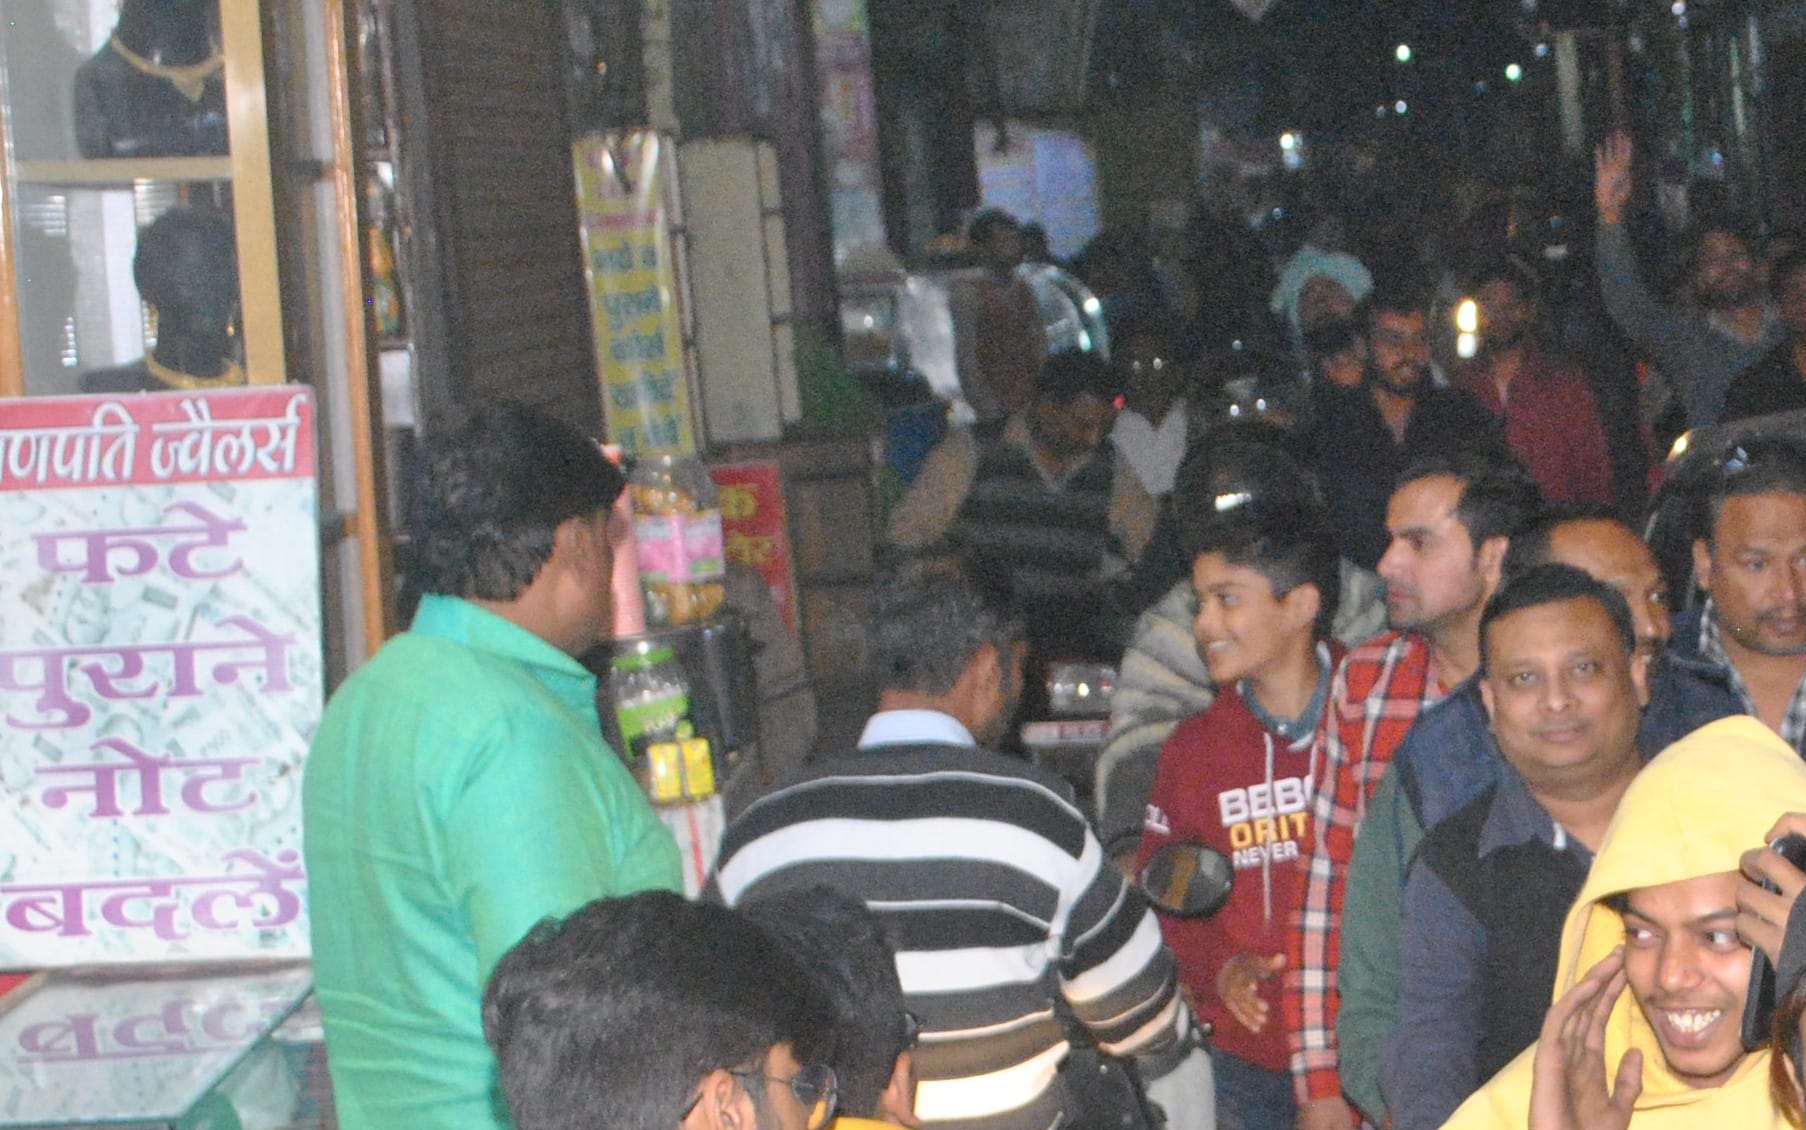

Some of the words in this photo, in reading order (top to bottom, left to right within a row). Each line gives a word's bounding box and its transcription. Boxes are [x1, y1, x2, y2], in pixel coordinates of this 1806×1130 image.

[0, 401, 140, 484] णपति
[31, 501, 247, 584] फटे
[0, 615, 297, 730] पुराने
[34, 738, 261, 818] नोट
[0, 850, 305, 940] बदलें
[1233, 841, 1298, 869] NEVER
